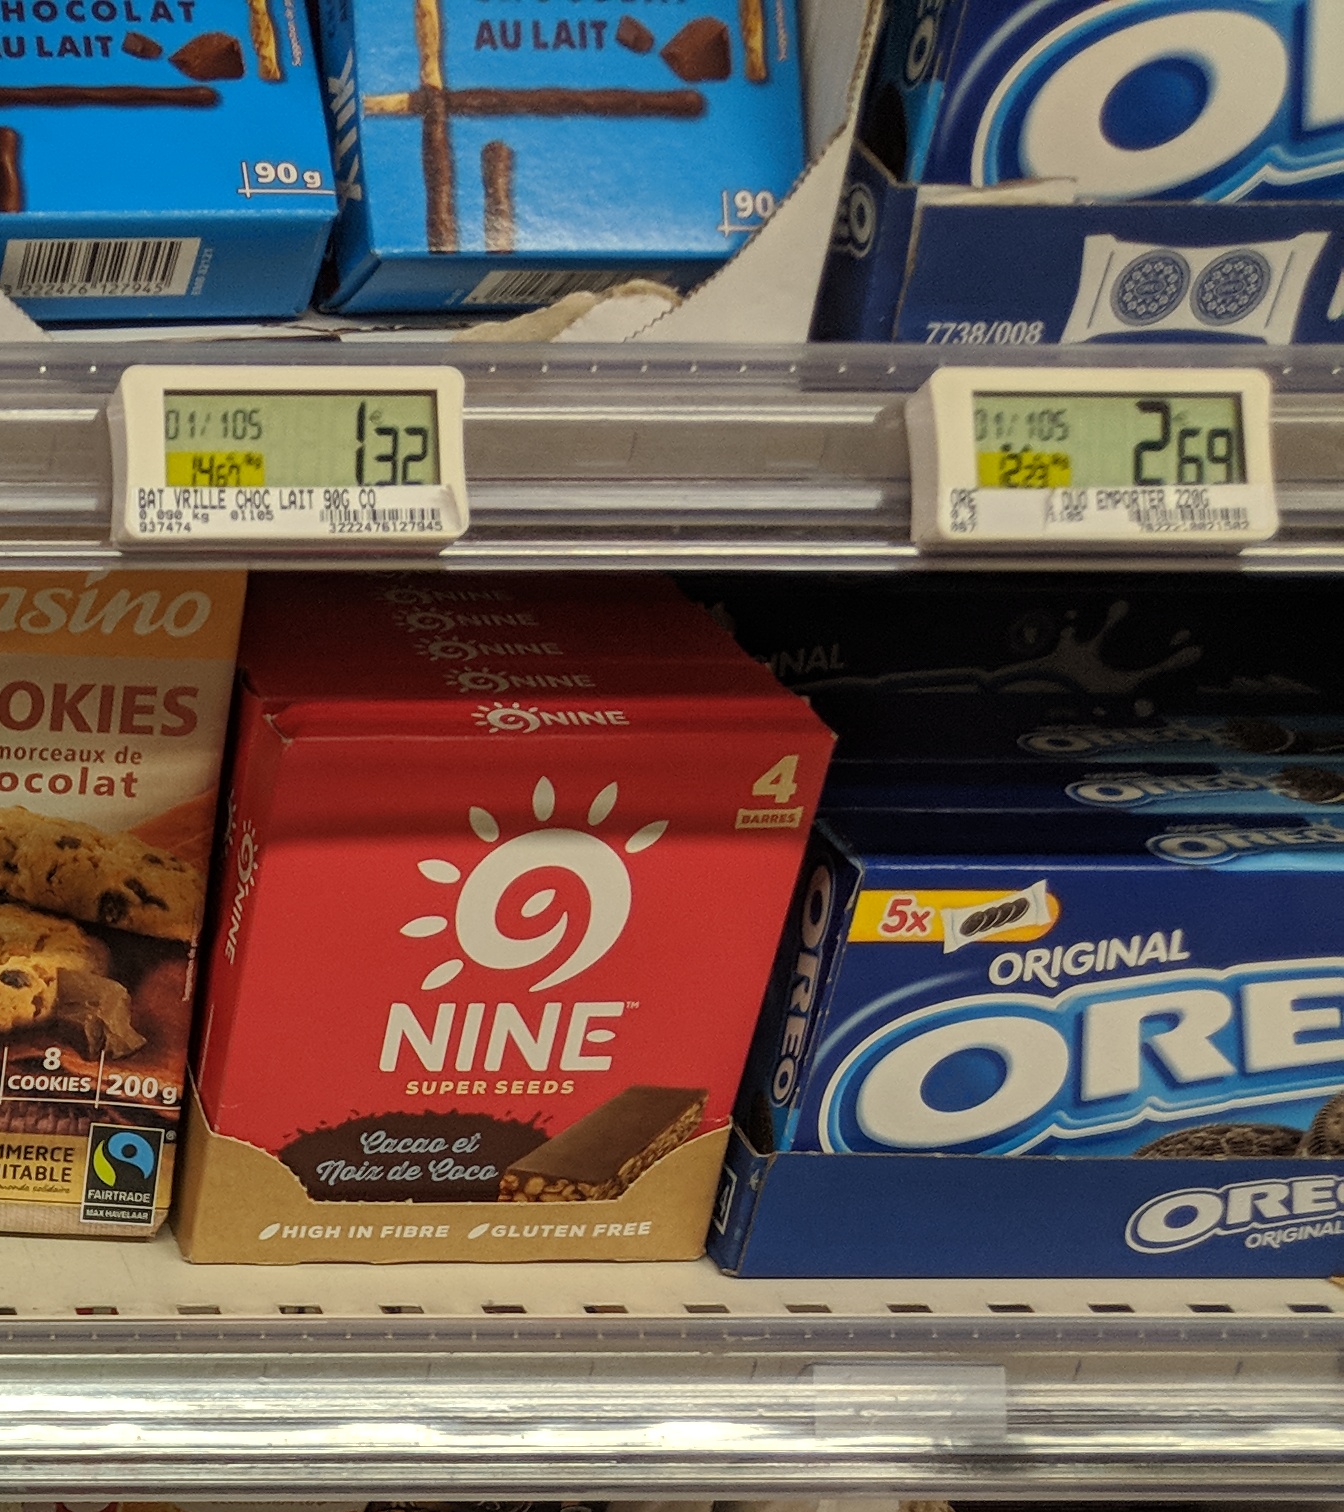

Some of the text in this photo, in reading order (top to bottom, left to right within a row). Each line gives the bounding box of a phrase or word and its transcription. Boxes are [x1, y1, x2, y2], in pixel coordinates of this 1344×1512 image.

[474, 19, 608, 51] AU LAIT
[35, 35, 114, 60] LAIT
[925, 321, 1044, 345] 7738/008
[138, 489, 165, 508] BAT
[174, 489, 226, 509] VRILLE
[235, 489, 271, 509] CHOC
[279, 489, 313, 509] LAIT
[139, 522, 192, 532] 937474
[539, 709, 631, 727] NINE
[112, 746, 143, 766] de
[752, 754, 800, 804] 4
[740, 811, 797, 826] BARRES
[880, 896, 932, 936] 5x
[988, 929, 1191, 988] ORIGINAL
[378, 1002, 624, 1073] NINE
[43, 1047, 61, 1070] 8
[8, 1075, 91, 1092] COOKIES
[405, 1080, 576, 1096] SUPER SEEDS
[87, 1189, 151, 1203] FAIRTRADE
[281, 1223, 450, 1241] HIGH IN FIBRE
[490, 1221, 652, 1240] GLUTEN FREE
